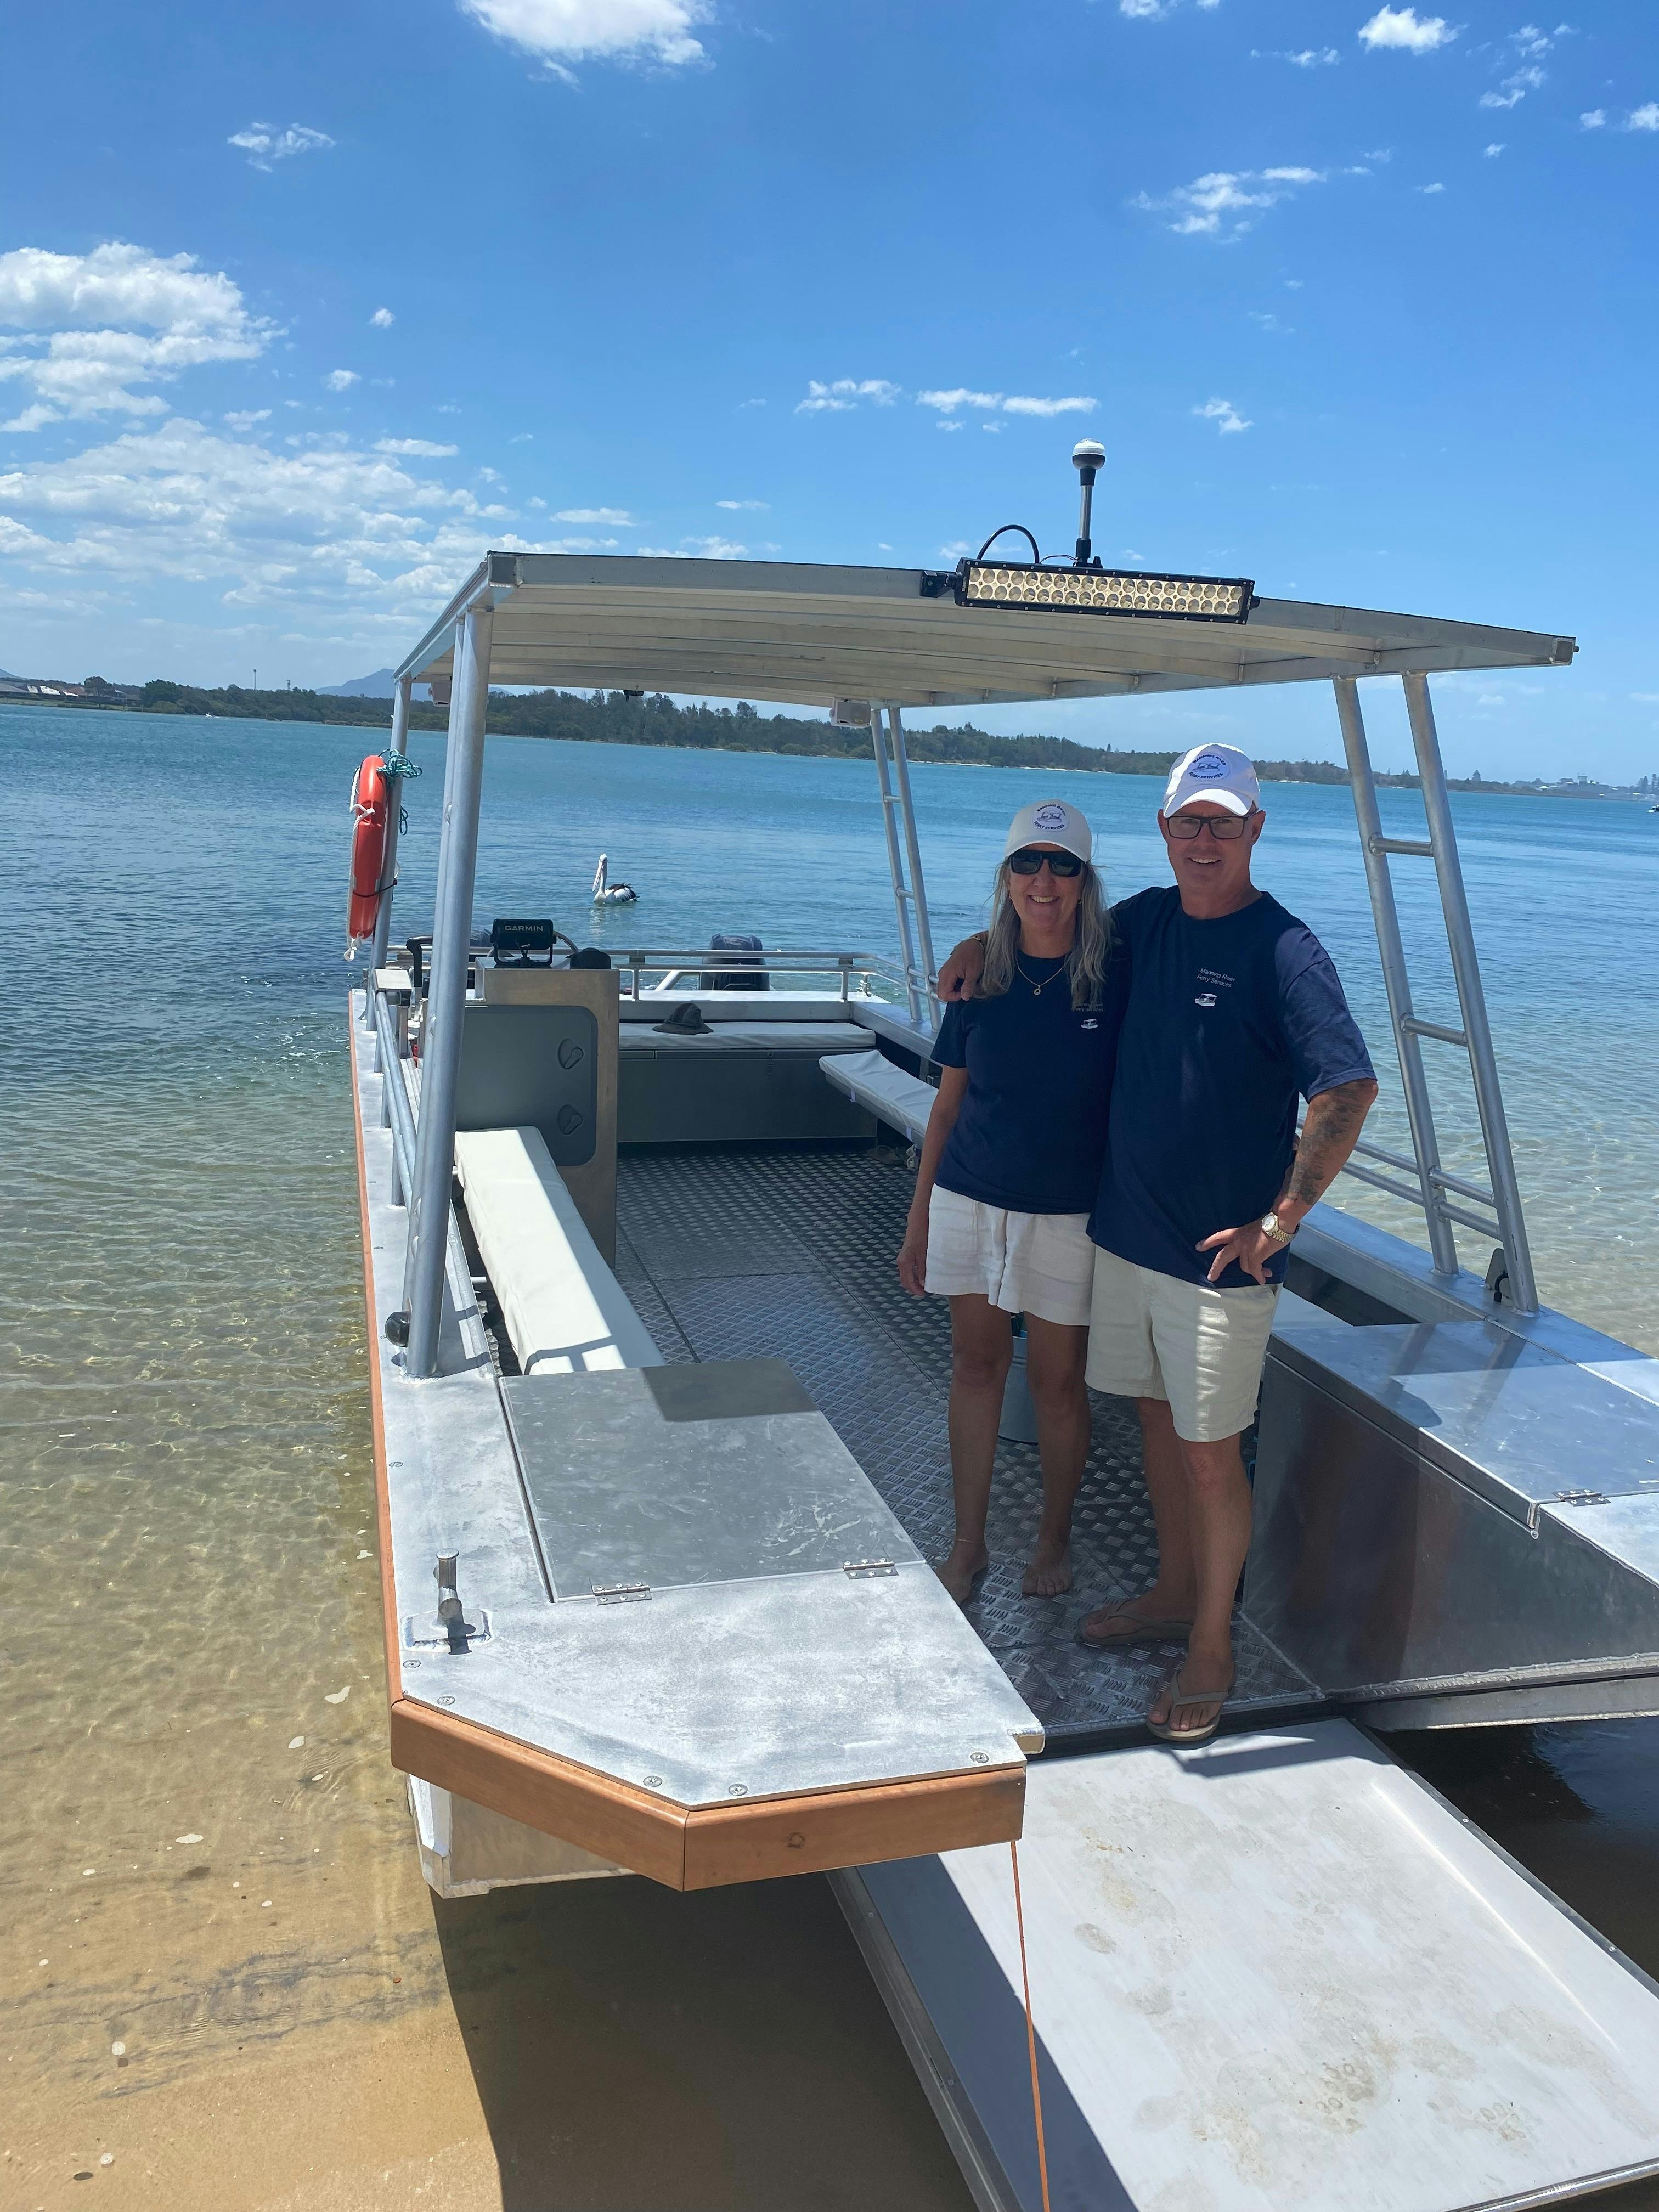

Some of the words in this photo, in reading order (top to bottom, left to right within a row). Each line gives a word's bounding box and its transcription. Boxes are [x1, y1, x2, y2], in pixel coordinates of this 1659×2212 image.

[1193, 754, 1215, 763] MANNING
[1215, 756, 1226, 765] RIVER
[1036, 804, 1056, 812] MANNING
[1057, 805, 1066, 816] RIVER
[1034, 820, 1045, 828] FERRY
[1197, 974, 1210, 983] Ferry
[1210, 978, 1232, 988] Services
[1200, 968, 1222, 979] Manning
[1221, 974, 1235, 982] River
